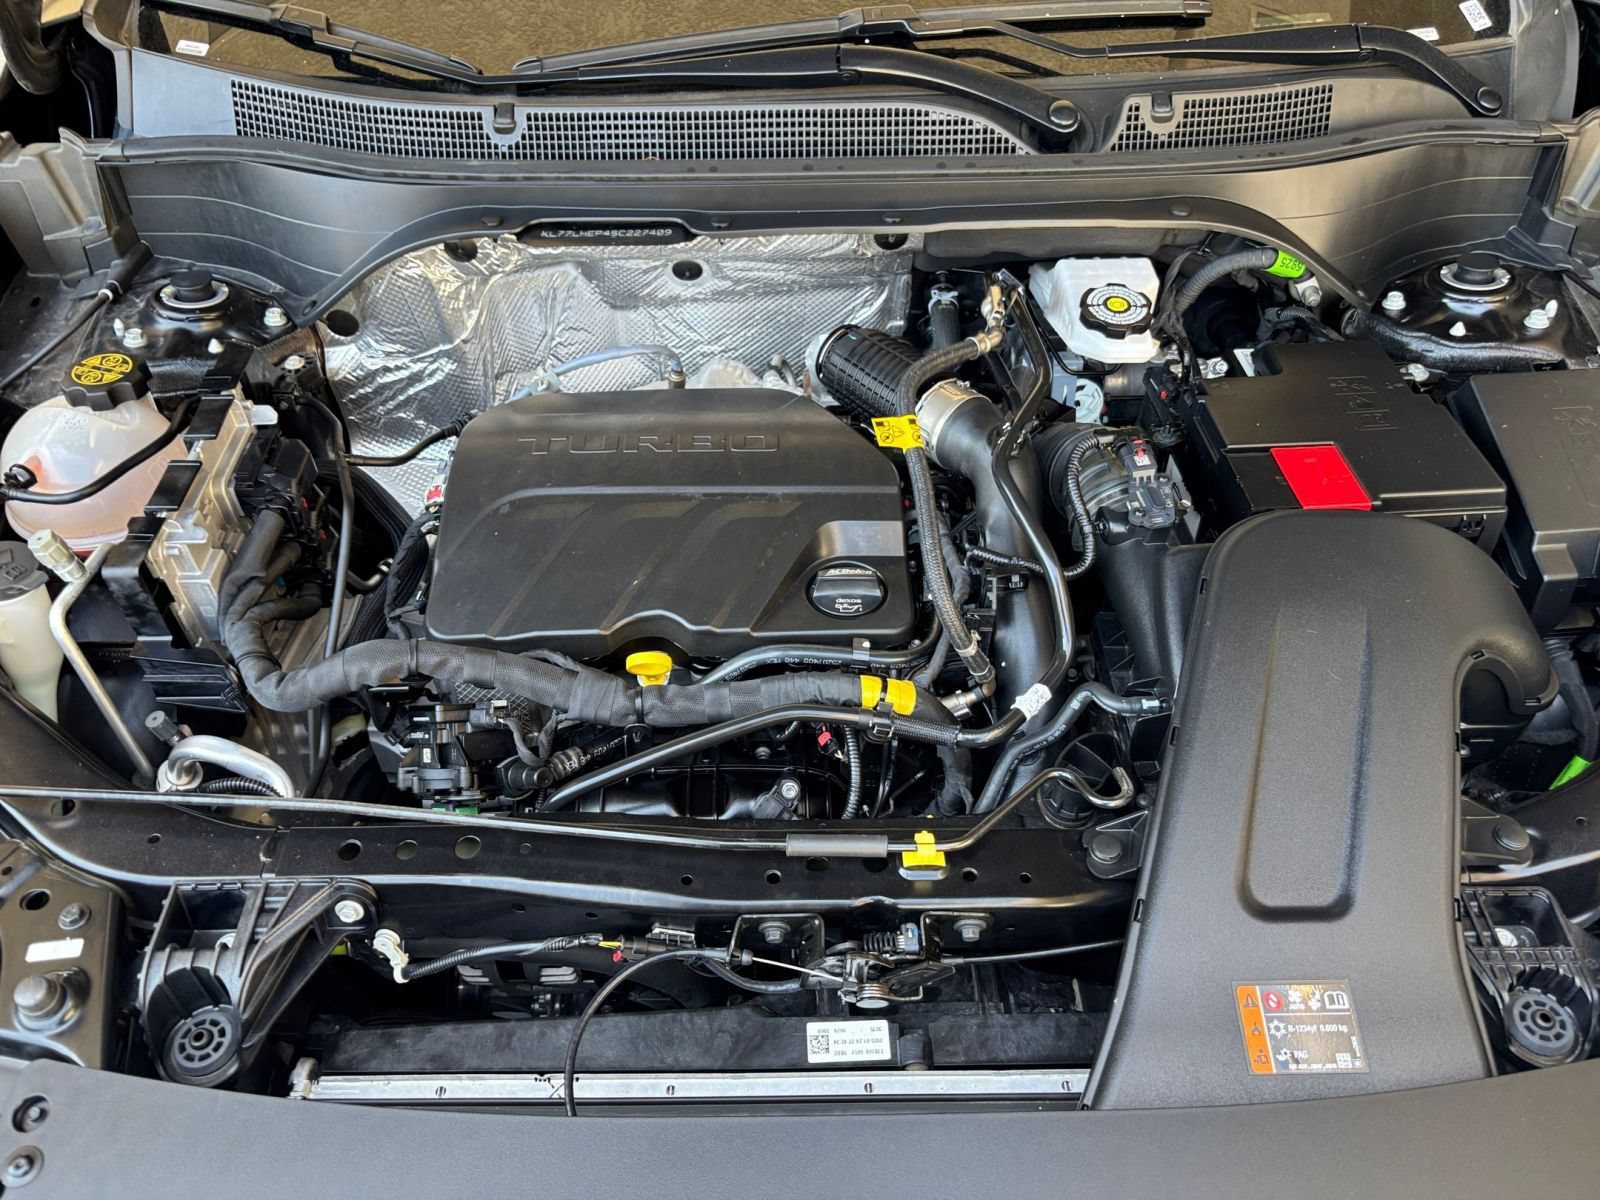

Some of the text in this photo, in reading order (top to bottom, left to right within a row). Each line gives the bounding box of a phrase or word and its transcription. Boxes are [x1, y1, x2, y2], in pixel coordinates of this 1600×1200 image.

[1280, 256, 1304, 272] 5925
[518, 434, 780, 455] TURBO
[825, 568, 873, 577] ACDelco
